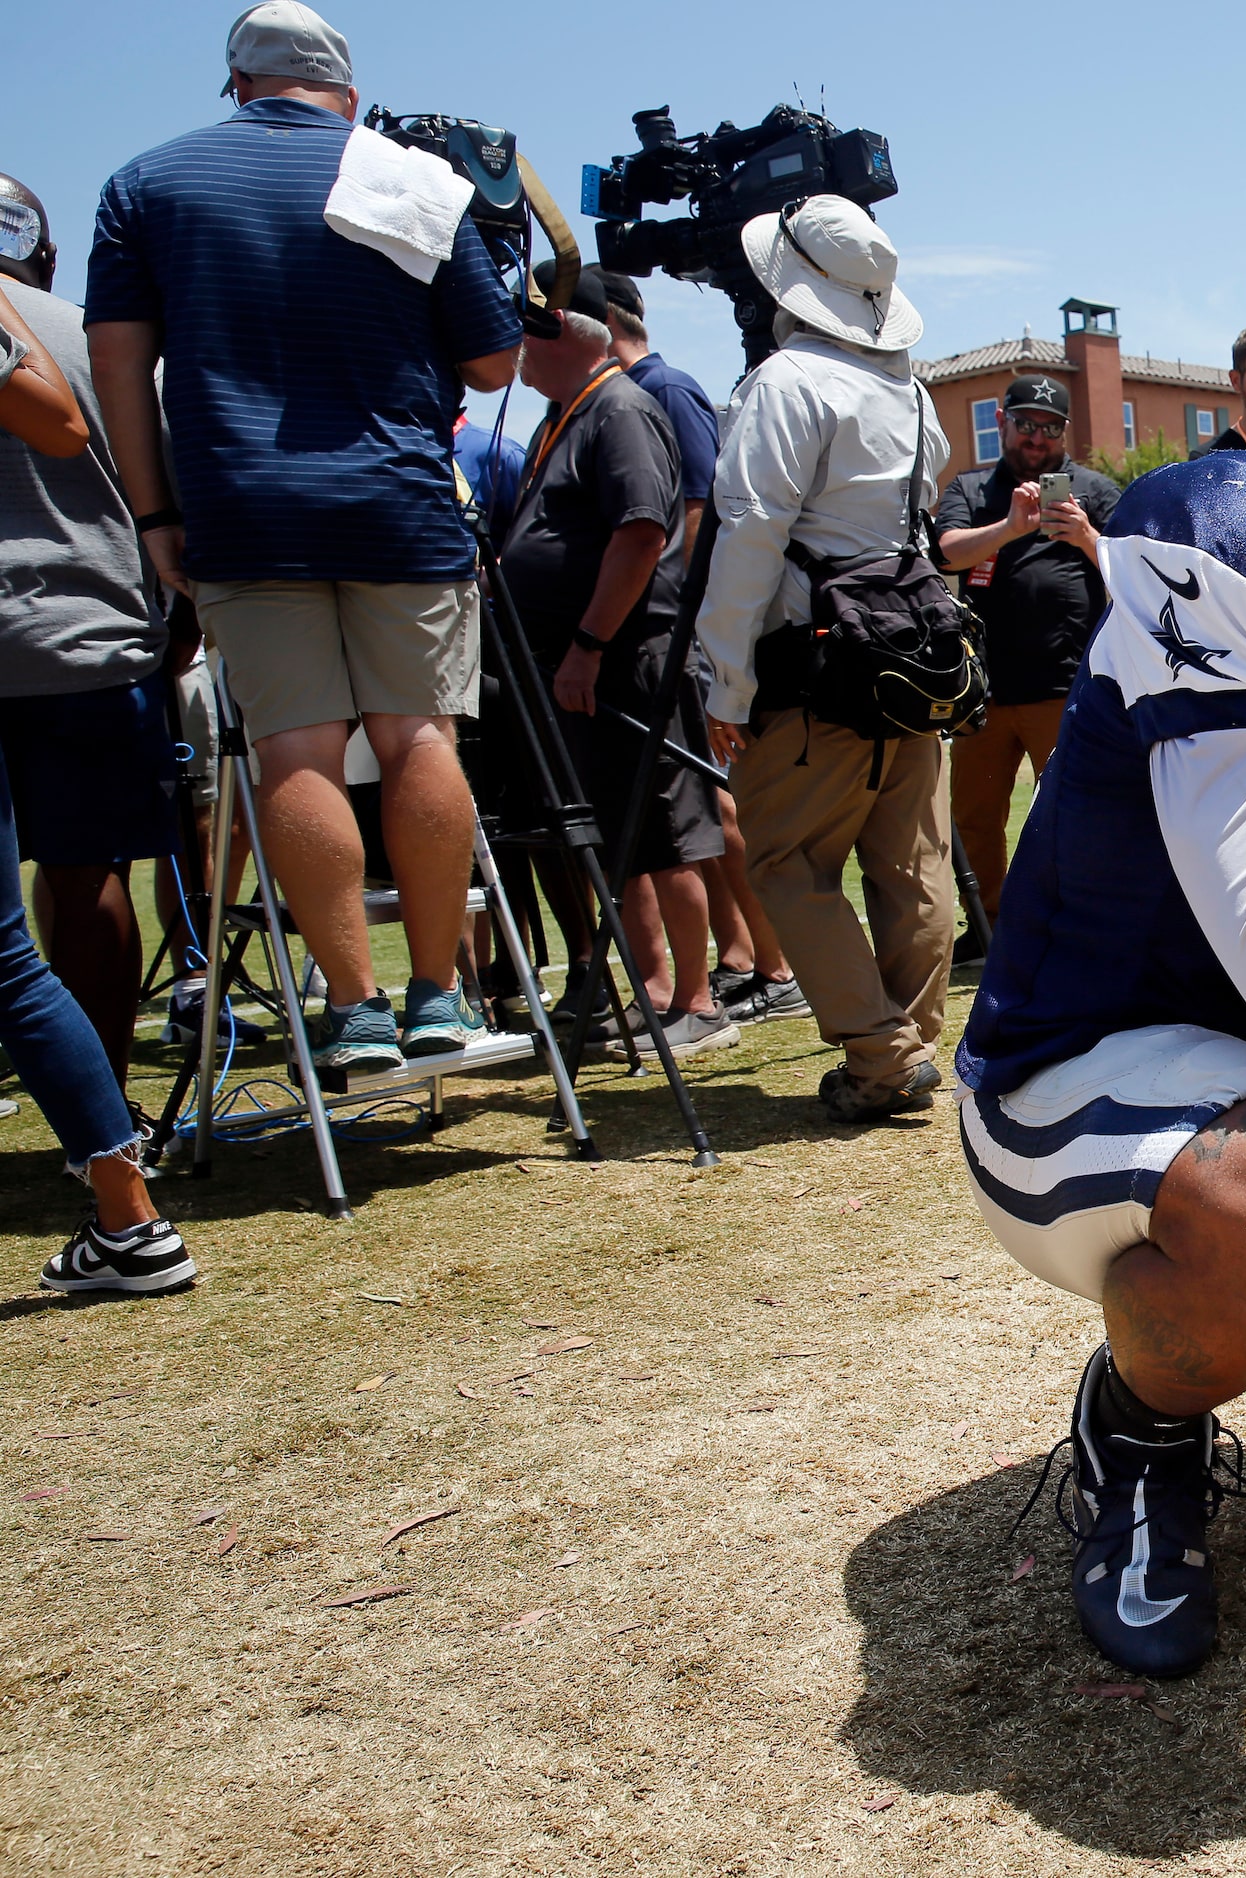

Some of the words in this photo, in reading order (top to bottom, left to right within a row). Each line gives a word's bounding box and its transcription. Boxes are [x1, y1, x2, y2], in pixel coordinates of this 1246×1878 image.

[289, 58, 315, 66] SUPER
[481, 145, 506, 155] ANTON
[152, 1220, 172, 1236] NIKE
